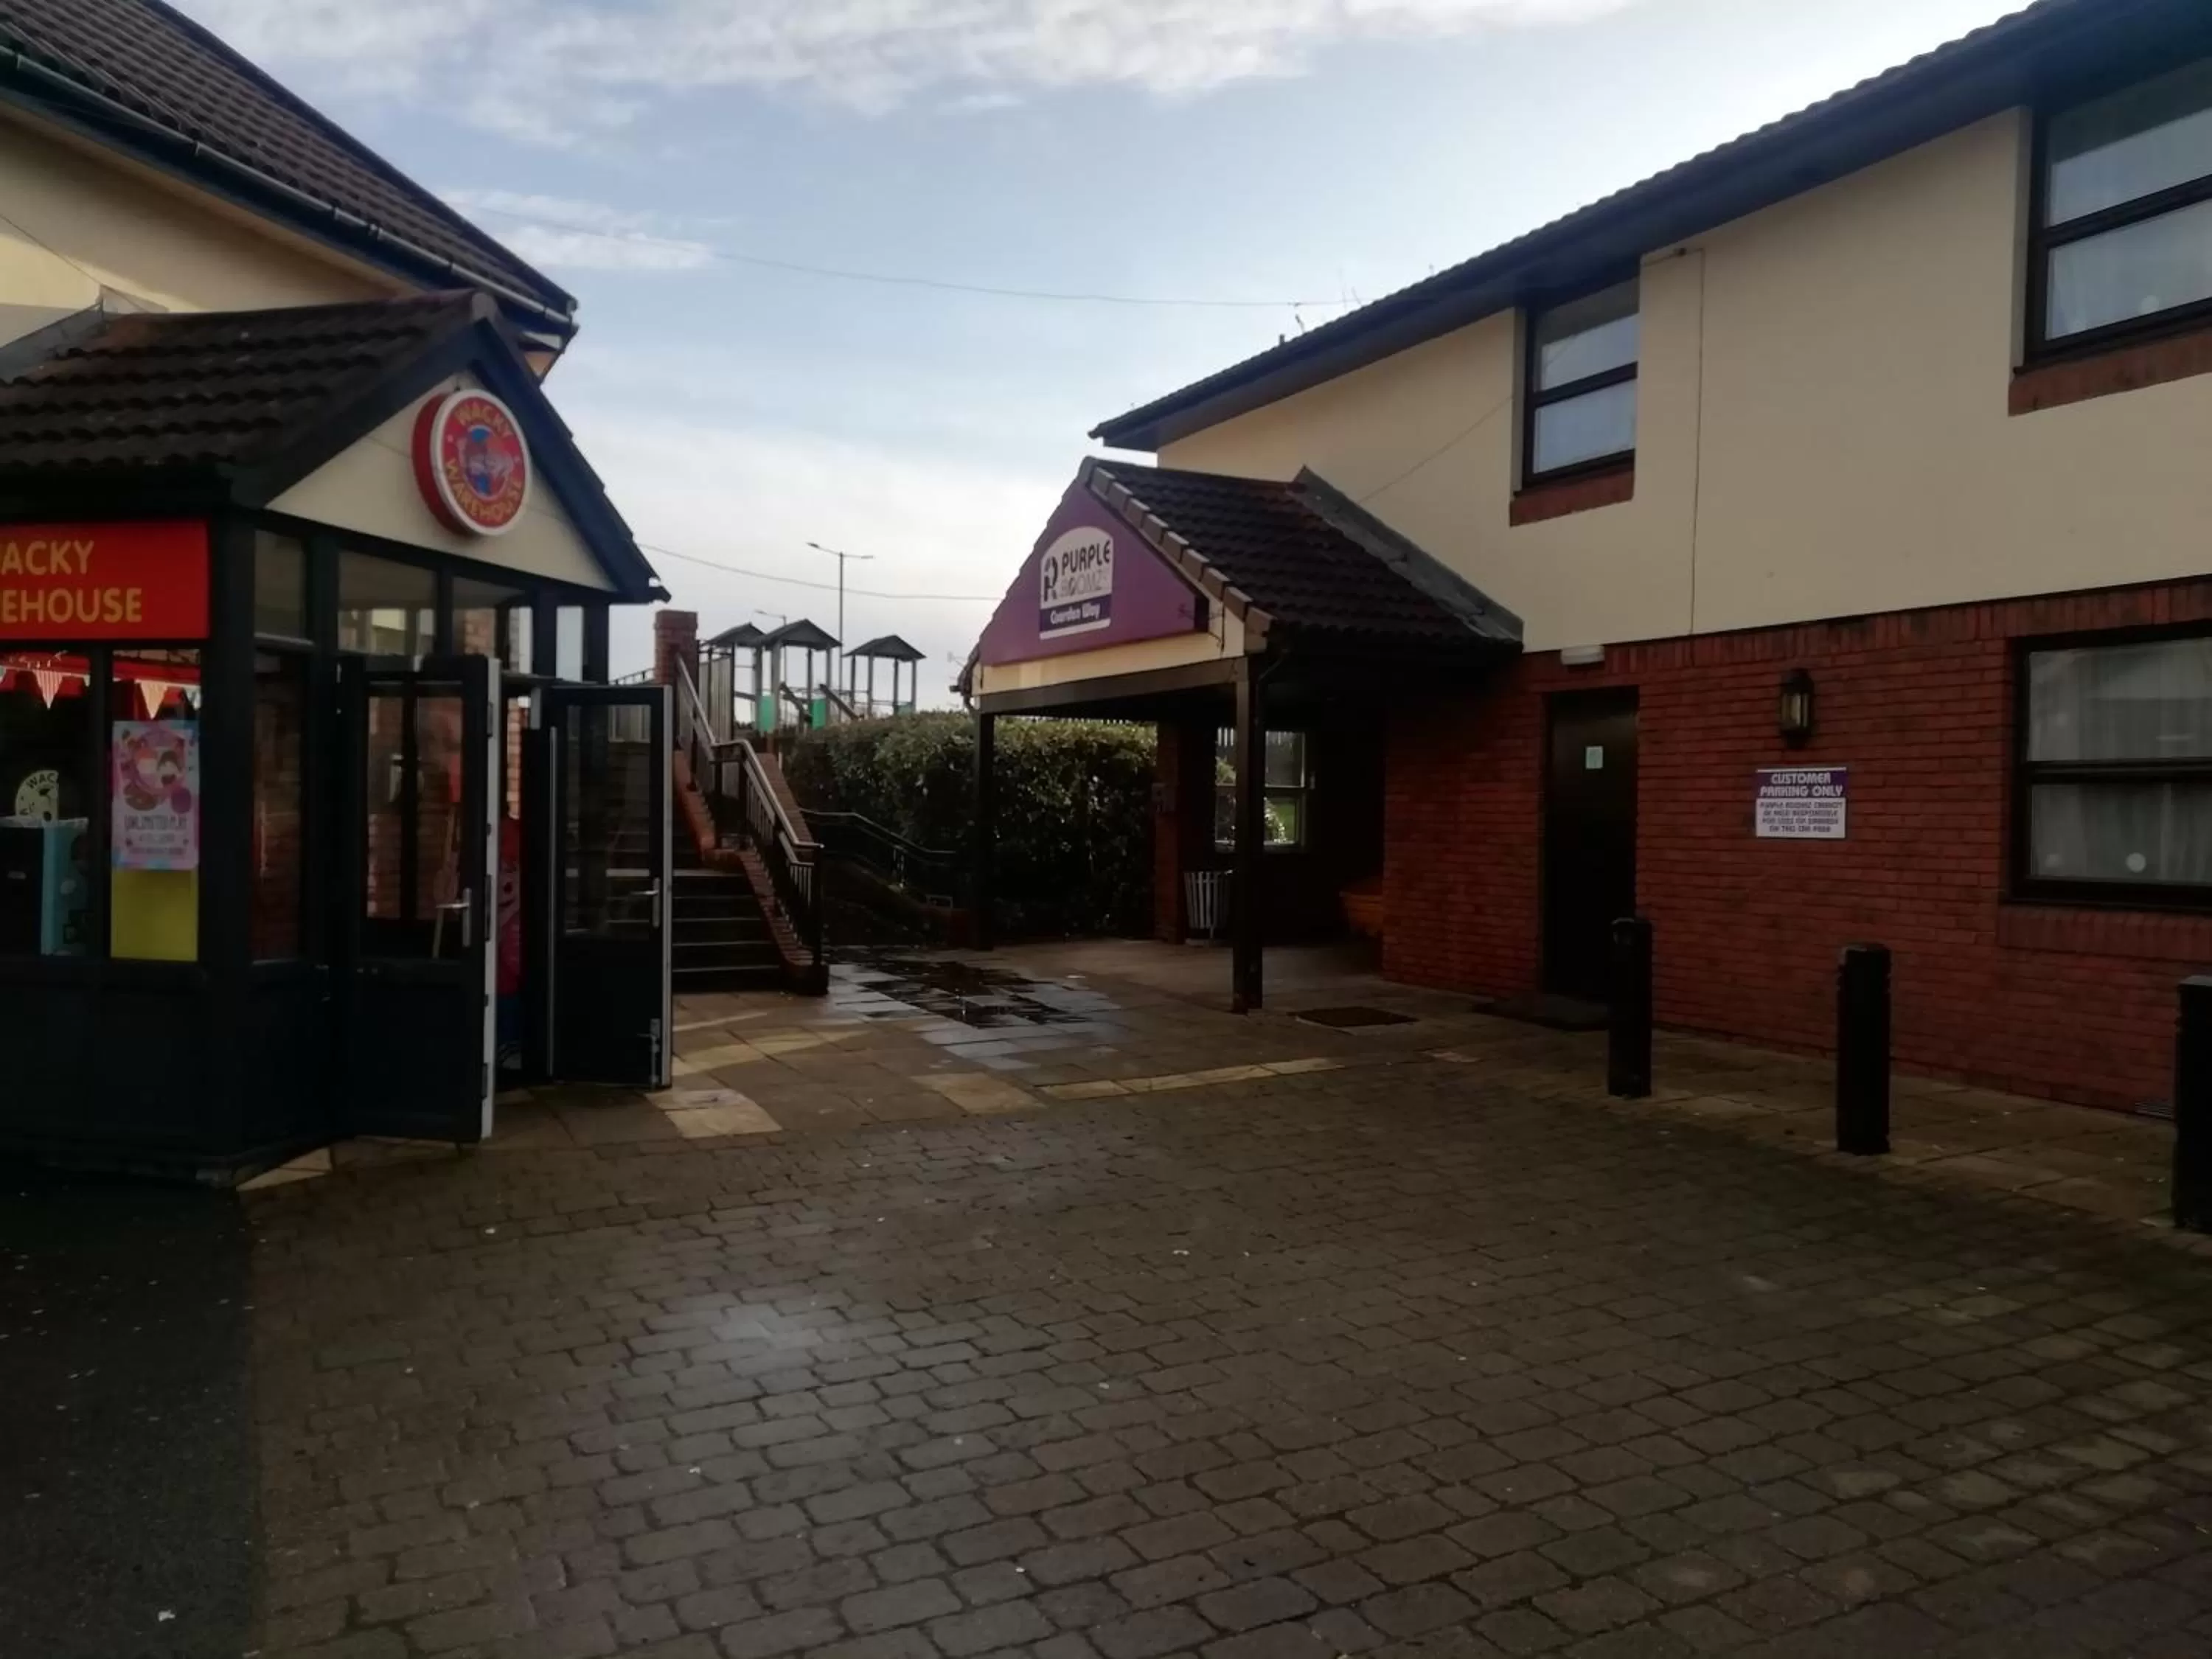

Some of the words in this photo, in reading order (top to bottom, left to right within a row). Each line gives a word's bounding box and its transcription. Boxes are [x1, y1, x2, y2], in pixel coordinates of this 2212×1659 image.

[1061, 540, 1111, 576] PURPLE
[1, 587, 142, 624] EHOUSE
[1770, 772, 1831, 785] CUSTOMER
[1759, 785, 1809, 797] PARKING
[1812, 785, 1843, 797] ONLY
